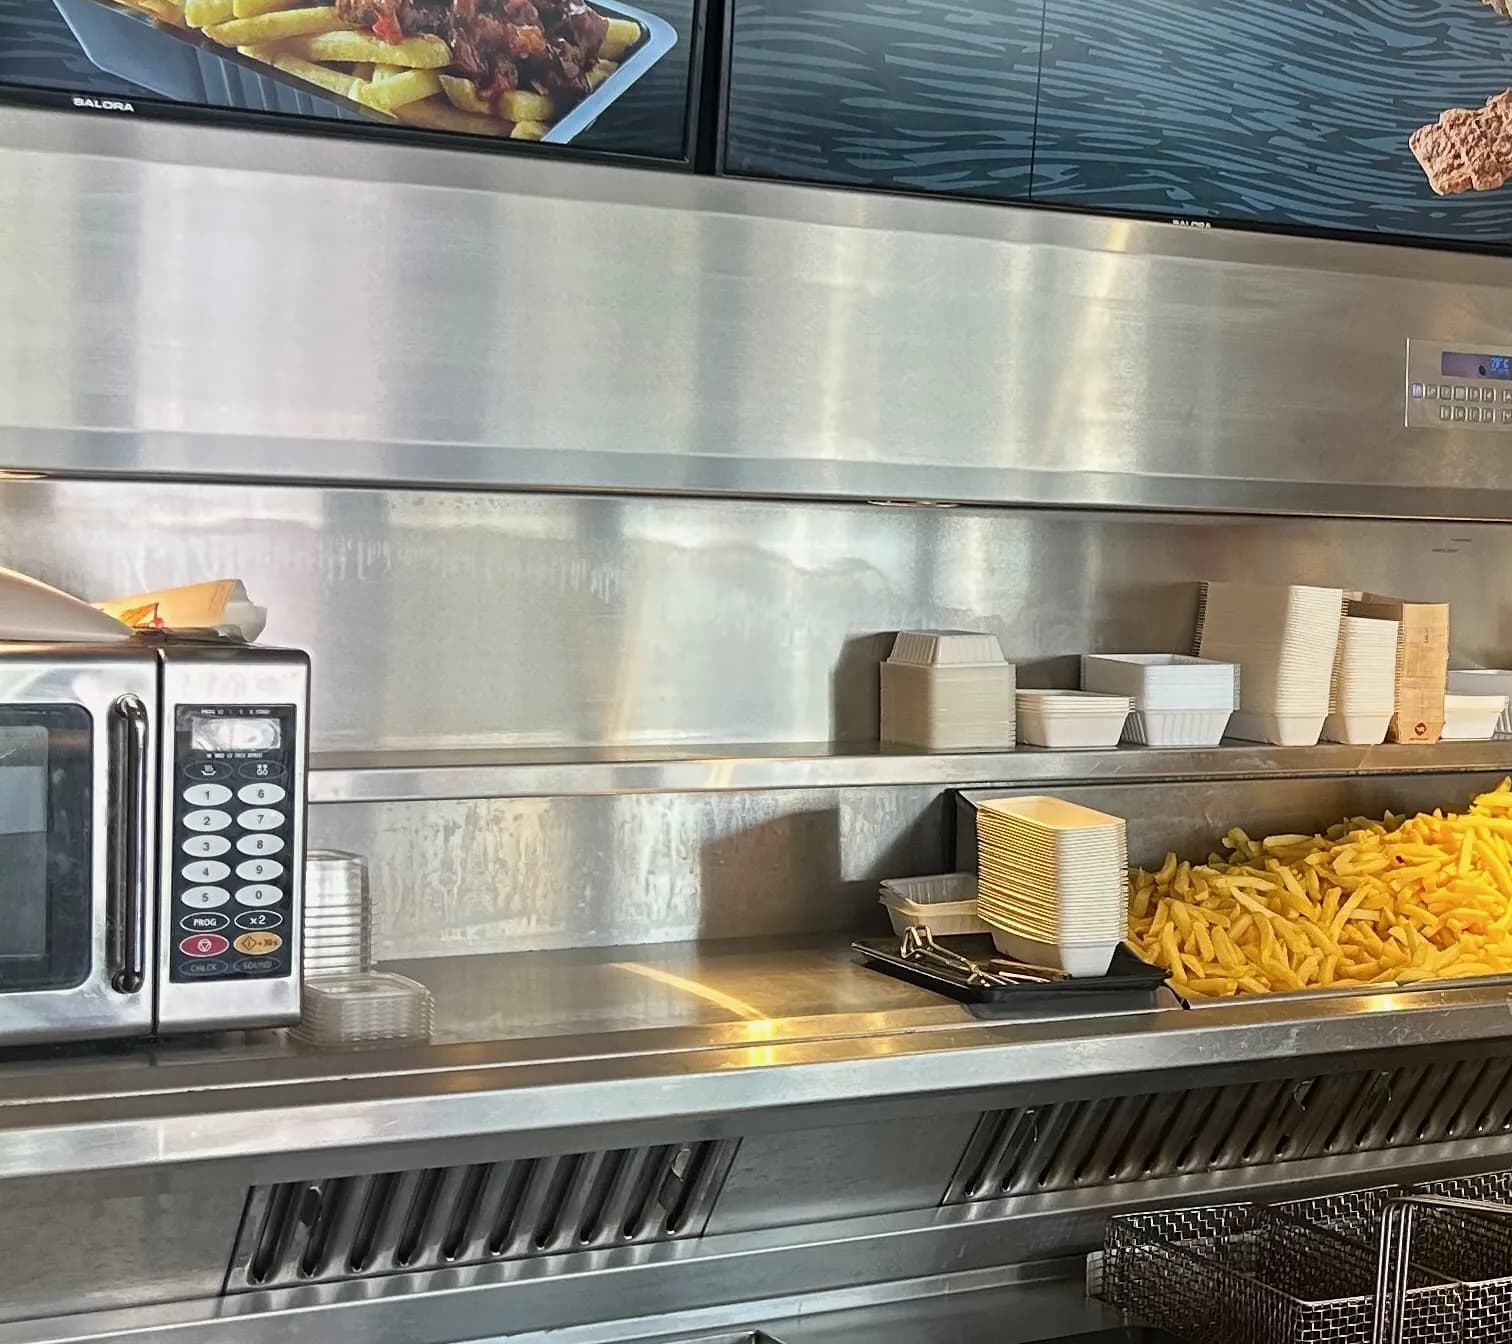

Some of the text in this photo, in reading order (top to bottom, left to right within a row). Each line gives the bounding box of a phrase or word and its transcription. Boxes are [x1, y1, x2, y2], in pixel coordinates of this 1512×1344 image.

[205, 789, 265, 800] 1 6
[203, 814, 265, 826] 2 7
[202, 839, 264, 852] 3 8
[202, 865, 264, 877] 4 9
[201, 889, 263, 903] 5 0
[193, 918, 217, 927] PROG
